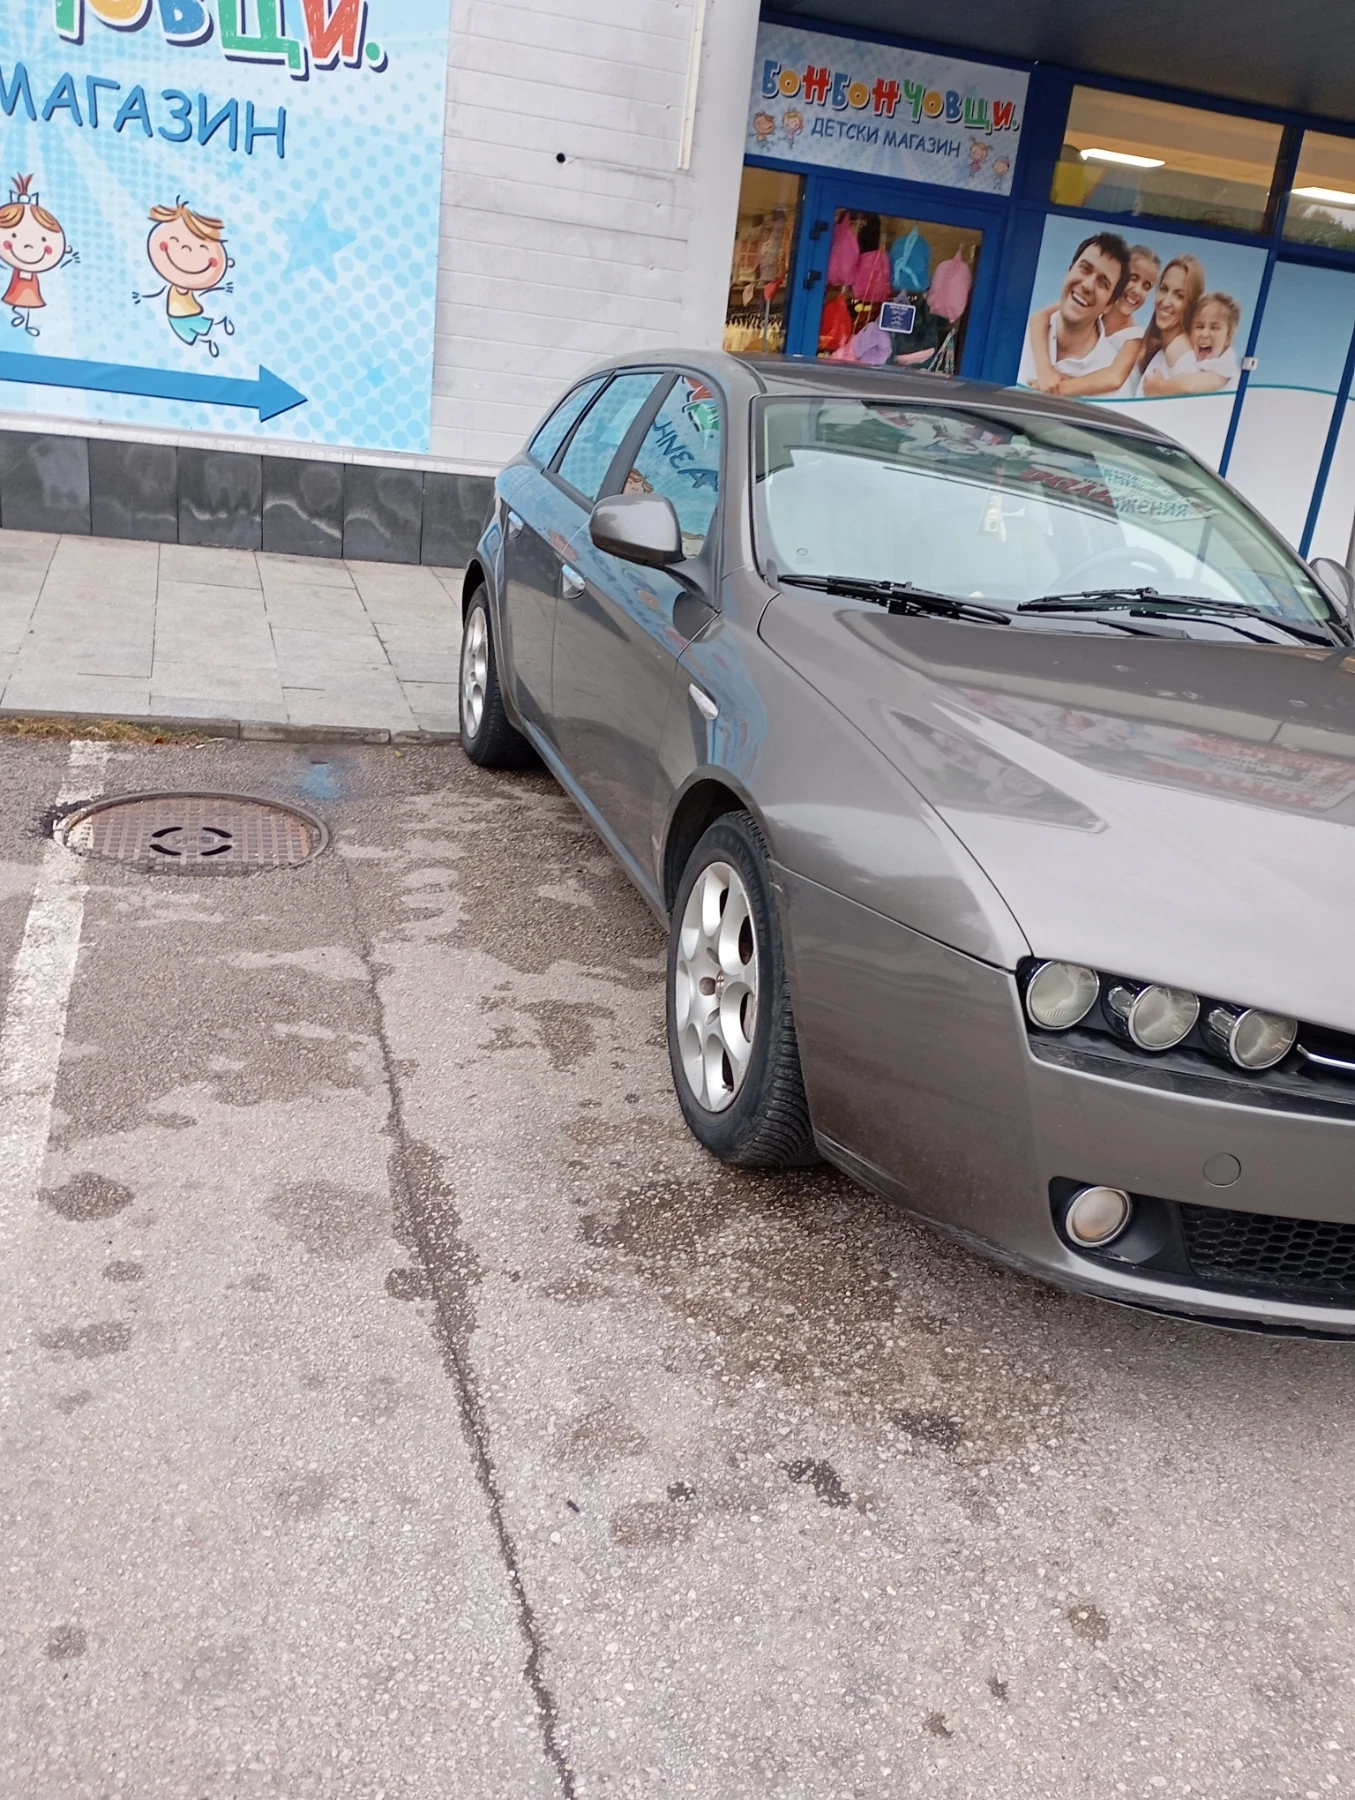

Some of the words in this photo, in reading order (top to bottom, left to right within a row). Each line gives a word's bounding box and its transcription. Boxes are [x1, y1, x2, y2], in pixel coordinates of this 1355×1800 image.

[0, 62, 286, 158] МАГАЗИН
[811, 117, 879, 144] ДЕТСКИ
[883, 130, 961, 158] МАГАЗИН
